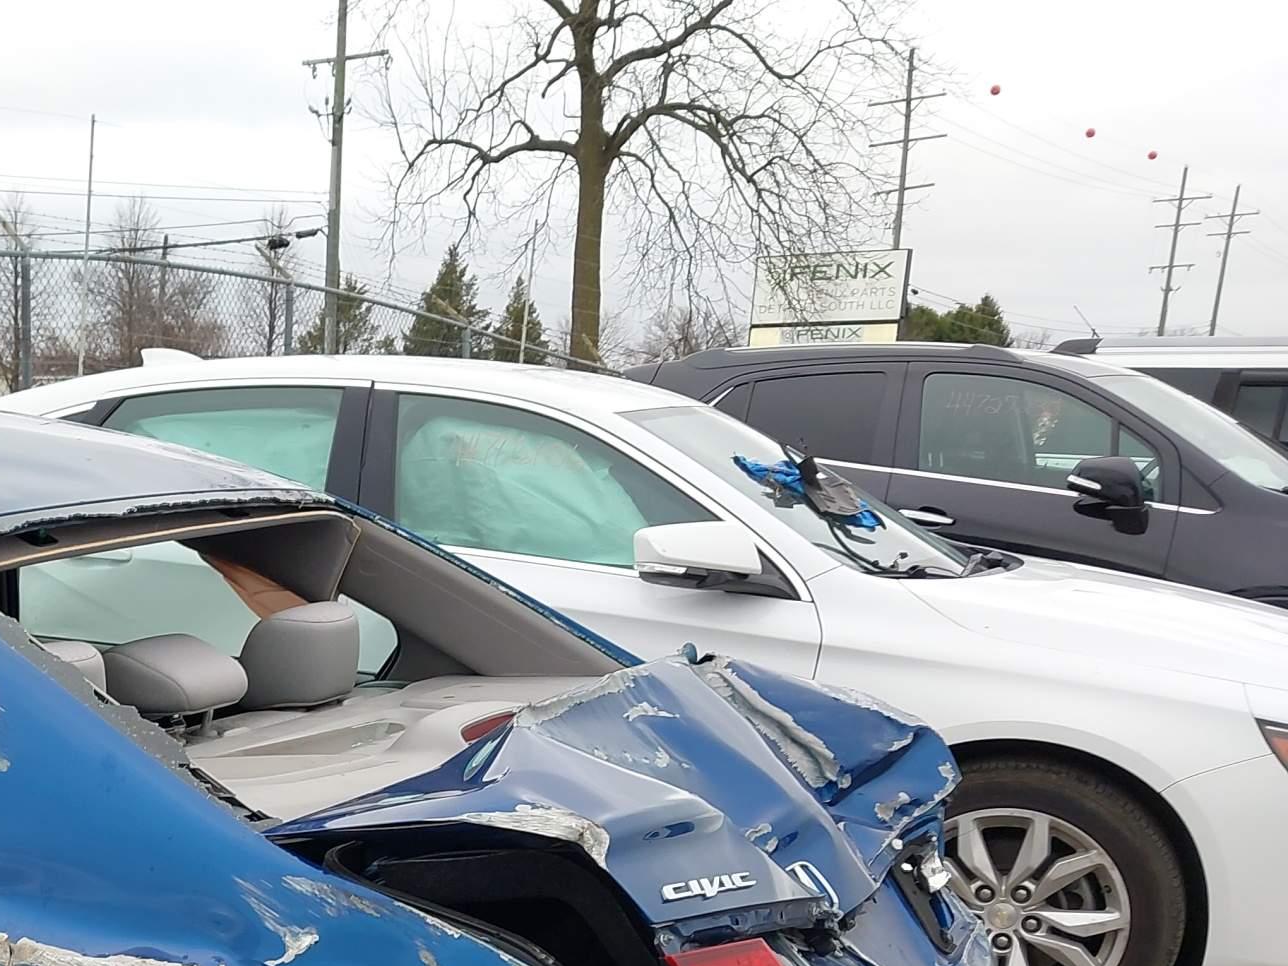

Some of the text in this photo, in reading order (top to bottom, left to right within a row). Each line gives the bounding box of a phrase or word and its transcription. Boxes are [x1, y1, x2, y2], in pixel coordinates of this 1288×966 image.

[790, 261, 895, 281] FENIX
[852, 286, 896, 299] PARTS
[819, 301, 865, 313] SOUTH
[869, 300, 895, 311] LLC
[796, 327, 862, 341] FENIX
[661, 871, 758, 902] CIVIC
